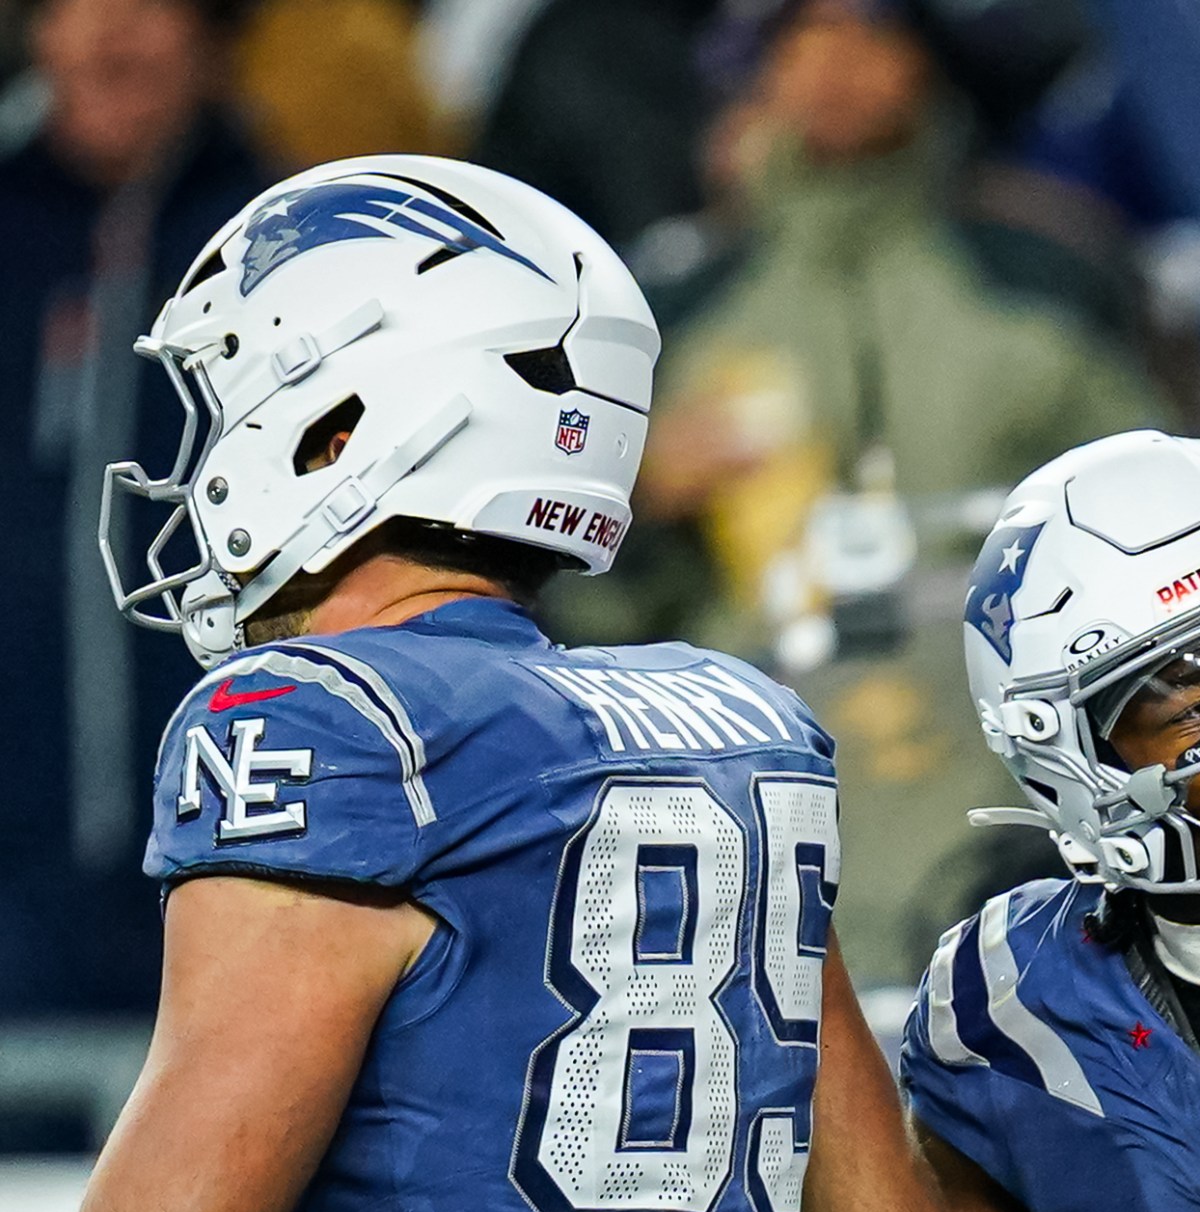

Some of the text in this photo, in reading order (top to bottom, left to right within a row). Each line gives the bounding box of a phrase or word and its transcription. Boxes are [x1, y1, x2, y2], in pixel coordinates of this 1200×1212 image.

[557, 425, 584, 451] NFL
[525, 497, 626, 551] NEW ENGL
[534, 664, 793, 752] HENRY
[176, 716, 315, 848] NE
